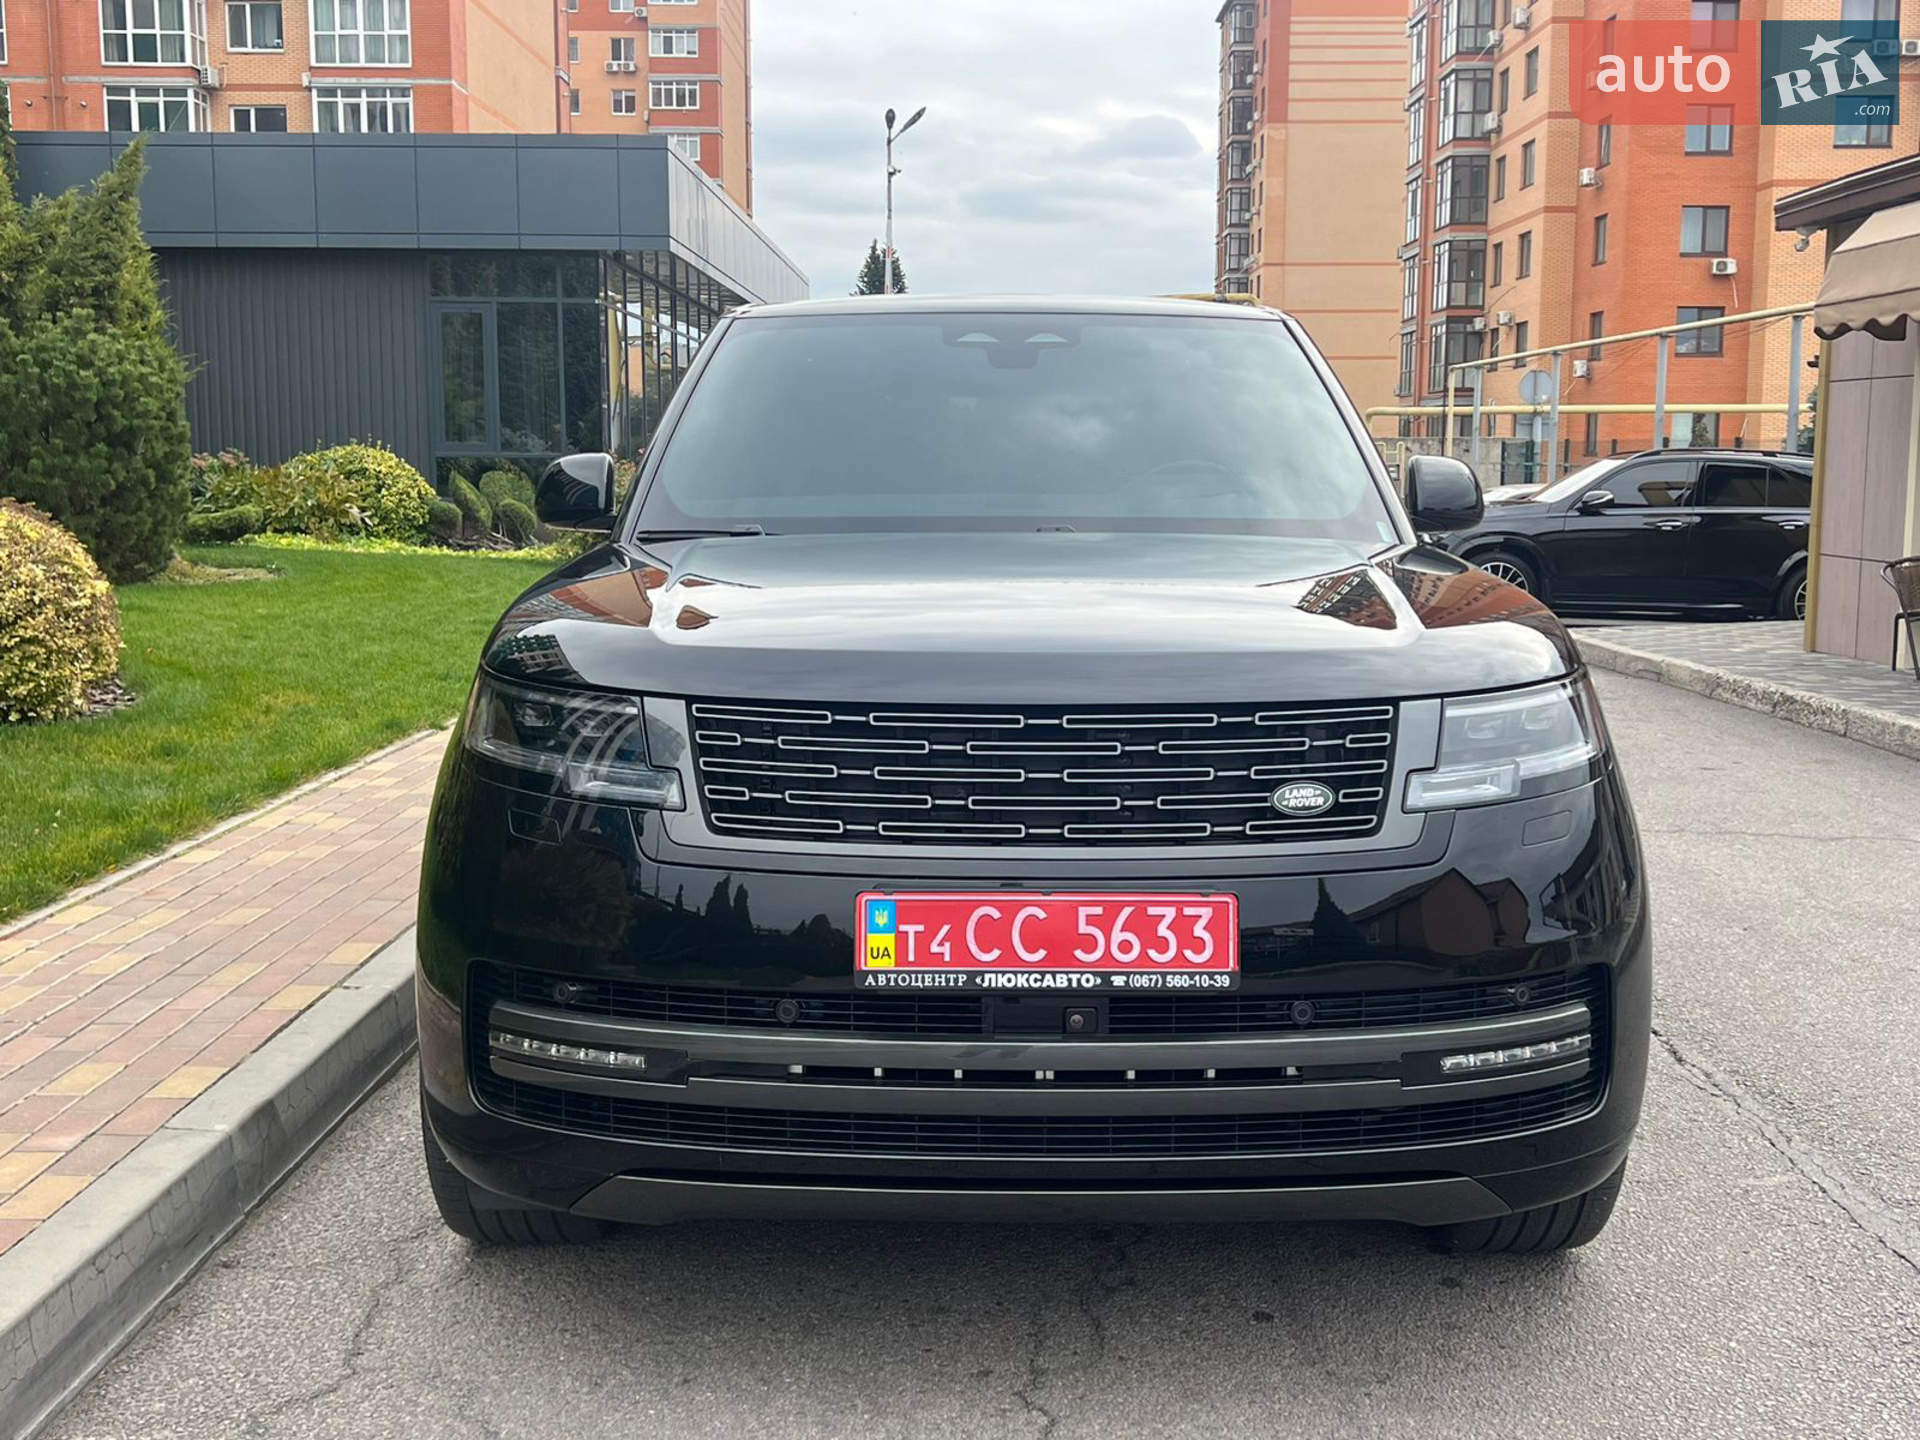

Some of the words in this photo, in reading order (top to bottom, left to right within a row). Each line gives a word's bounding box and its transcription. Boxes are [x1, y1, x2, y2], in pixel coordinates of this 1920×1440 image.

[1285, 788, 1314, 798] LAND
[1288, 797, 1324, 807] ROVER
[1073, 906, 1214, 964] 5633
[870, 946, 892, 960] UA
[864, 973, 967, 988] АВТОЦЕНТР
[975, 973, 1102, 988] «ЛЮКСАВТО»
[1165, 974, 1231, 988] 560-10-39
